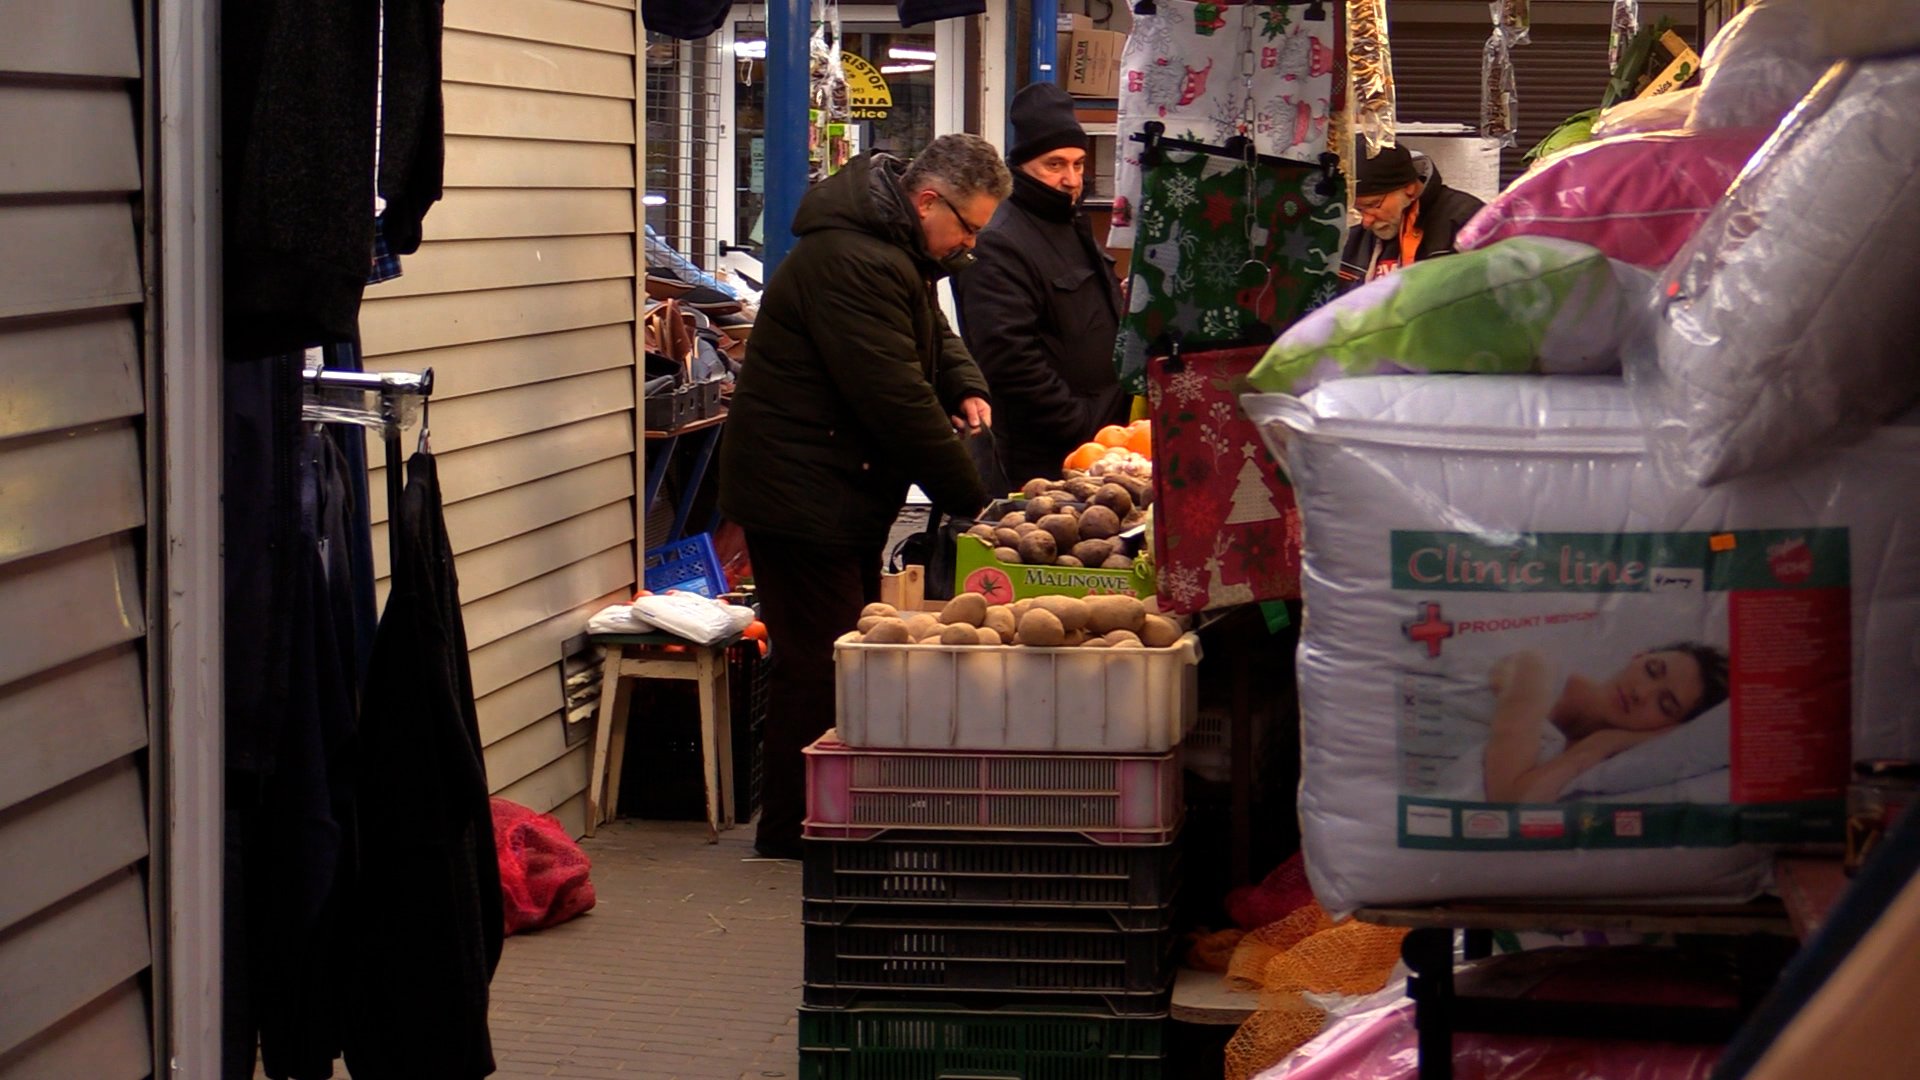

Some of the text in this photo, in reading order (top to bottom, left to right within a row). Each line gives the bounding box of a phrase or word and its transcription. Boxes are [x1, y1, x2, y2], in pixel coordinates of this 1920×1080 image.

[841, 54, 885, 91] RISTOF
[1074, 41, 1088, 81] TAYLOR
[850, 108, 888, 118] wice
[1408, 544, 1645, 585] Clinic line
[1025, 569, 1128, 590] MALINOWE
[1458, 615, 1541, 635] PRODUKT
